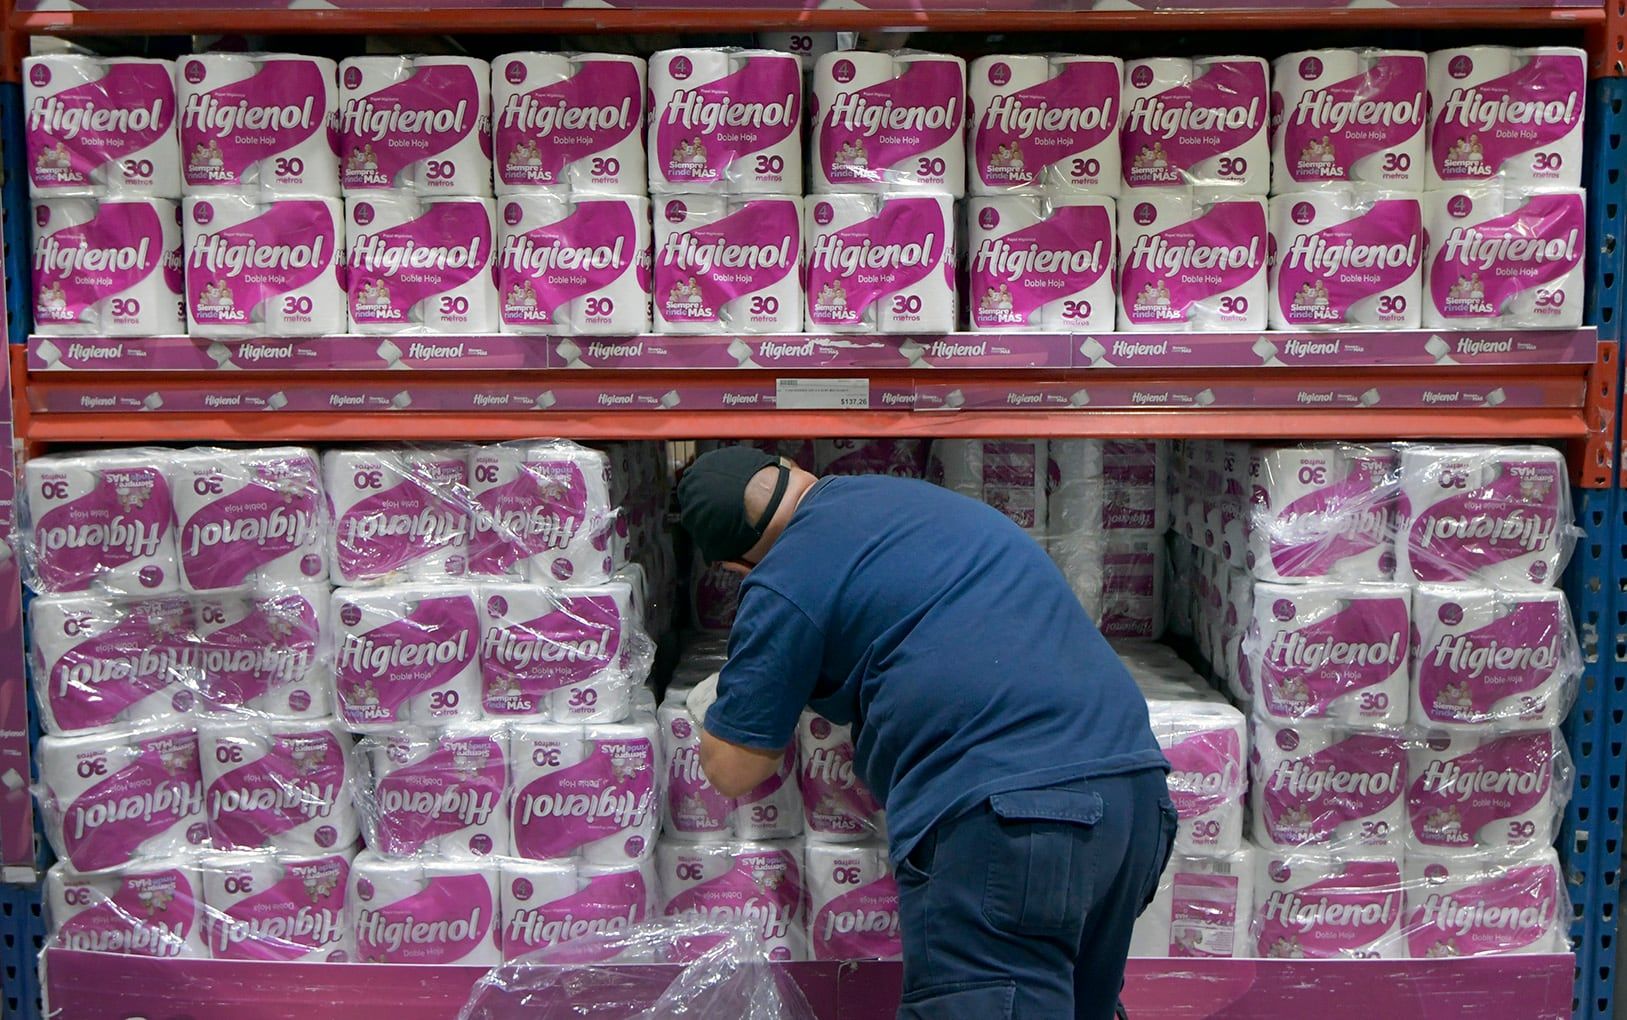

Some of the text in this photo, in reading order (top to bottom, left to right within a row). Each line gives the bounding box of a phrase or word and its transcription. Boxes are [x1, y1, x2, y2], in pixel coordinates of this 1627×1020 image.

[789, 35, 812, 50] 30
[31, 97, 163, 139] Higienol
[186, 95, 310, 138] Higienol
[504, 95, 629, 137] Higienol
[669, 90, 792, 133] Higienol
[832, 93, 954, 137] Higienol
[987, 95, 1110, 139] Higienol
[1131, 97, 1259, 139] Higienol
[1297, 90, 1419, 133] Higienol
[1445, 89, 1574, 132] Higienol
[344, 99, 466, 141] Higienol
[81, 137, 124, 146] Doble Hoja
[235, 136, 276, 144] Doble Hoja
[388, 139, 428, 147] Doble Hoja
[554, 135, 593, 145] Doble Hoja
[717, 133, 757, 142] Doble Hoja
[879, 135, 919, 145] Doble Hoja
[1345, 130, 1386, 140] Doble Hoja
[123, 160, 153, 177] 30
[275, 158, 303, 176] 30
[506, 164, 539, 172] Siempre
[591, 157, 619, 176] 30
[669, 161, 703, 170] Siempre
[754, 155, 783, 173] 30
[916, 158, 945, 176] 30
[1071, 159, 1099, 177] 30
[1218, 158, 1246, 175] 30
[1382, 153, 1410, 171] 30
[1443, 163, 1491, 175] rinde MÁS
[1444, 159, 1478, 168] Siempre
[1532, 152, 1562, 170] 30
[58, 169, 82, 181] MÁS
[208, 168, 234, 180] MÁS
[426, 161, 455, 179] 30
[527, 167, 552, 180] MÁS
[692, 165, 717, 177] MÁS
[1153, 168, 1177, 181] MÁS
[1321, 164, 1343, 176] MÁS
[35, 237, 148, 277] Higienol
[193, 235, 319, 277] Higienol
[354, 235, 479, 276] Higienol
[504, 235, 624, 276] Higienol
[665, 232, 789, 275] Higienol
[815, 233, 933, 276] Higienol
[1133, 235, 1258, 277] Higienol
[1290, 233, 1416, 276] Higienol
[1445, 228, 1578, 270] Higienol
[977, 239, 1101, 281] Higienol
[424, 275, 441, 283] Hoja
[713, 273, 752, 282] Doble Hoja
[1182, 275, 1221, 284] Doble Hoja
[1340, 274, 1380, 283] Doble Hoja
[282, 296, 312, 314] 30
[440, 297, 468, 314] 30
[749, 296, 778, 314] 30
[892, 295, 921, 313] 30
[1219, 297, 1248, 314] 30
[1377, 296, 1406, 314] 30
[1535, 289, 1565, 306] 30
[112, 298, 139, 316] 30
[219, 307, 245, 319] MÁS
[525, 307, 546, 319] MÁS
[584, 298, 613, 315] 30
[832, 307, 856, 319] MÁS
[1062, 300, 1091, 318] 30
[68, 344, 122, 361] Higienol
[239, 344, 292, 361] Higienol
[409, 344, 463, 360] Higienol
[588, 342, 642, 360] Higienol
[760, 342, 814, 359] Higienol
[932, 341, 986, 358] Higienol
[1113, 340, 1167, 358] Higienol
[1284, 339, 1339, 357] Higienol
[1457, 337, 1512, 355] Higienol
[81, 396, 116, 406] Higienol
[205, 394, 240, 406] Higienol
[330, 394, 364, 406] Higienol
[473, 394, 508, 405] Higienol
[598, 394, 632, 404] Higienol
[723, 393, 758, 404] Higienol
[882, 392, 917, 404] Higienol
[1007, 392, 1042, 404] Higienol
[1132, 392, 1168, 403] Higienol
[1297, 391, 1333, 403] Higienol
[1422, 391, 1459, 403] Higienol
[354, 472, 382, 489] 30
[475, 464, 499, 483] 30
[1298, 468, 1327, 484] 30
[41, 481, 69, 500] 30
[193, 477, 223, 496] 30
[40, 516, 161, 556] Higienol
[191, 506, 323, 556] Higienol
[348, 509, 468, 547] Higienol
[1423, 510, 1552, 551] Higienol
[341, 630, 468, 677] Higienol
[483, 628, 608, 669] Higienol
[1272, 630, 1398, 678] Higienol
[1435, 635, 1557, 678] Higienol
[390, 672, 432, 681] Doble Hoja
[430, 691, 458, 708] 30
[569, 688, 597, 706] 30
[1360, 693, 1388, 709] 30
[216, 746, 242, 763] 30
[532, 749, 561, 767] 30
[77, 759, 108, 778] 30
[1275, 760, 1398, 800] Higienol
[1424, 760, 1546, 800] Higienol
[213, 780, 335, 820] Higienol
[382, 784, 493, 825] Higienol
[522, 786, 649, 828] Higienol
[1492, 800, 1511, 808] Hoja
[75, 780, 203, 839] Higienol
[751, 805, 778, 822] 30
[1192, 821, 1220, 838] 30
[1360, 821, 1388, 837] 30
[1508, 821, 1535, 837] 30
[676, 864, 704, 880] 30
[833, 867, 860, 883] 30
[224, 876, 253, 893] 30
[64, 888, 91, 905] 30
[1268, 891, 1391, 934] Higienol
[1422, 894, 1549, 935] Higienol
[221, 907, 344, 951] Higienol
[359, 907, 480, 952] Higienol
